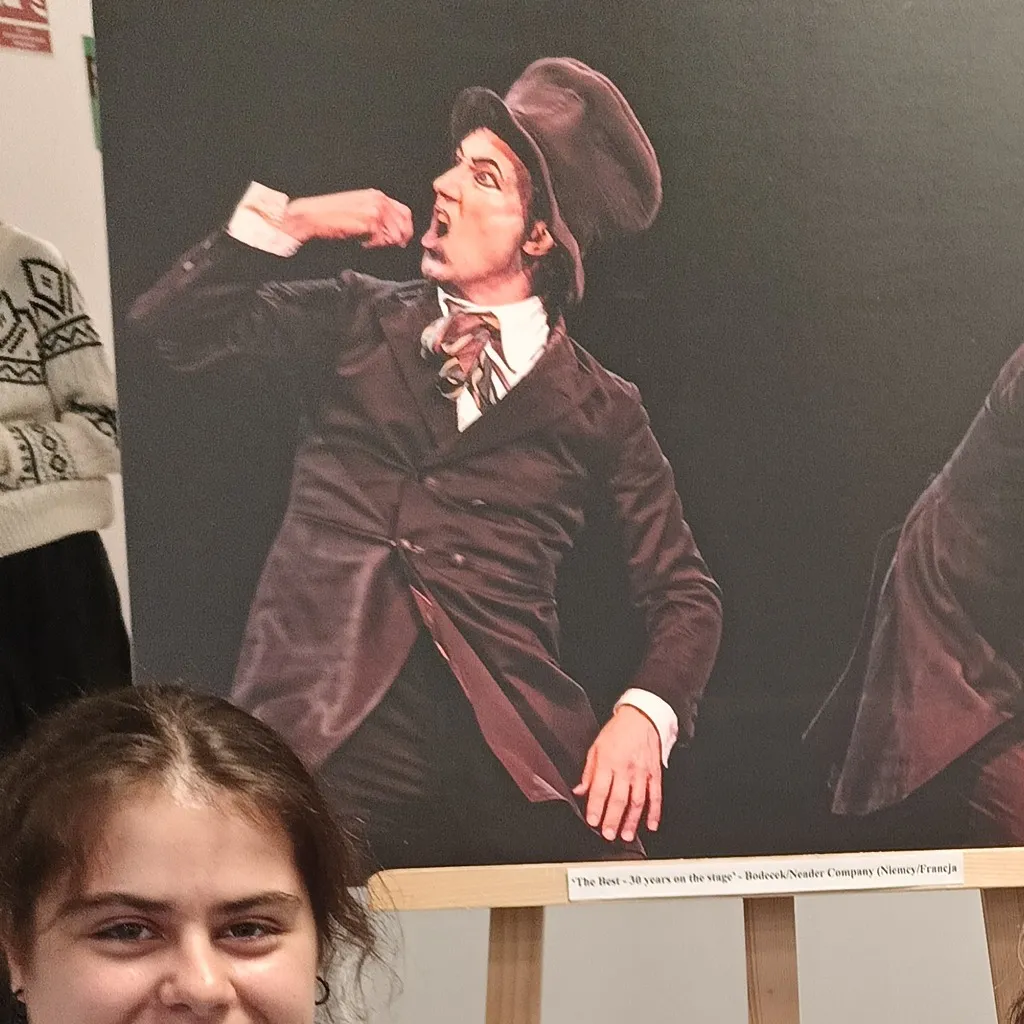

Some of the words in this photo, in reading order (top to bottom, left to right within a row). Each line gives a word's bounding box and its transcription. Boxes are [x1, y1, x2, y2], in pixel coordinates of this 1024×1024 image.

[598, 875, 620, 886] Best
[628, 874, 641, 885] 30
[643, 875, 671, 887] years
[673, 875, 686, 883] on
[689, 873, 705, 883] the
[827, 867, 874, 879] Company
[876, 863, 958, 877] (Niemcy/Francja
